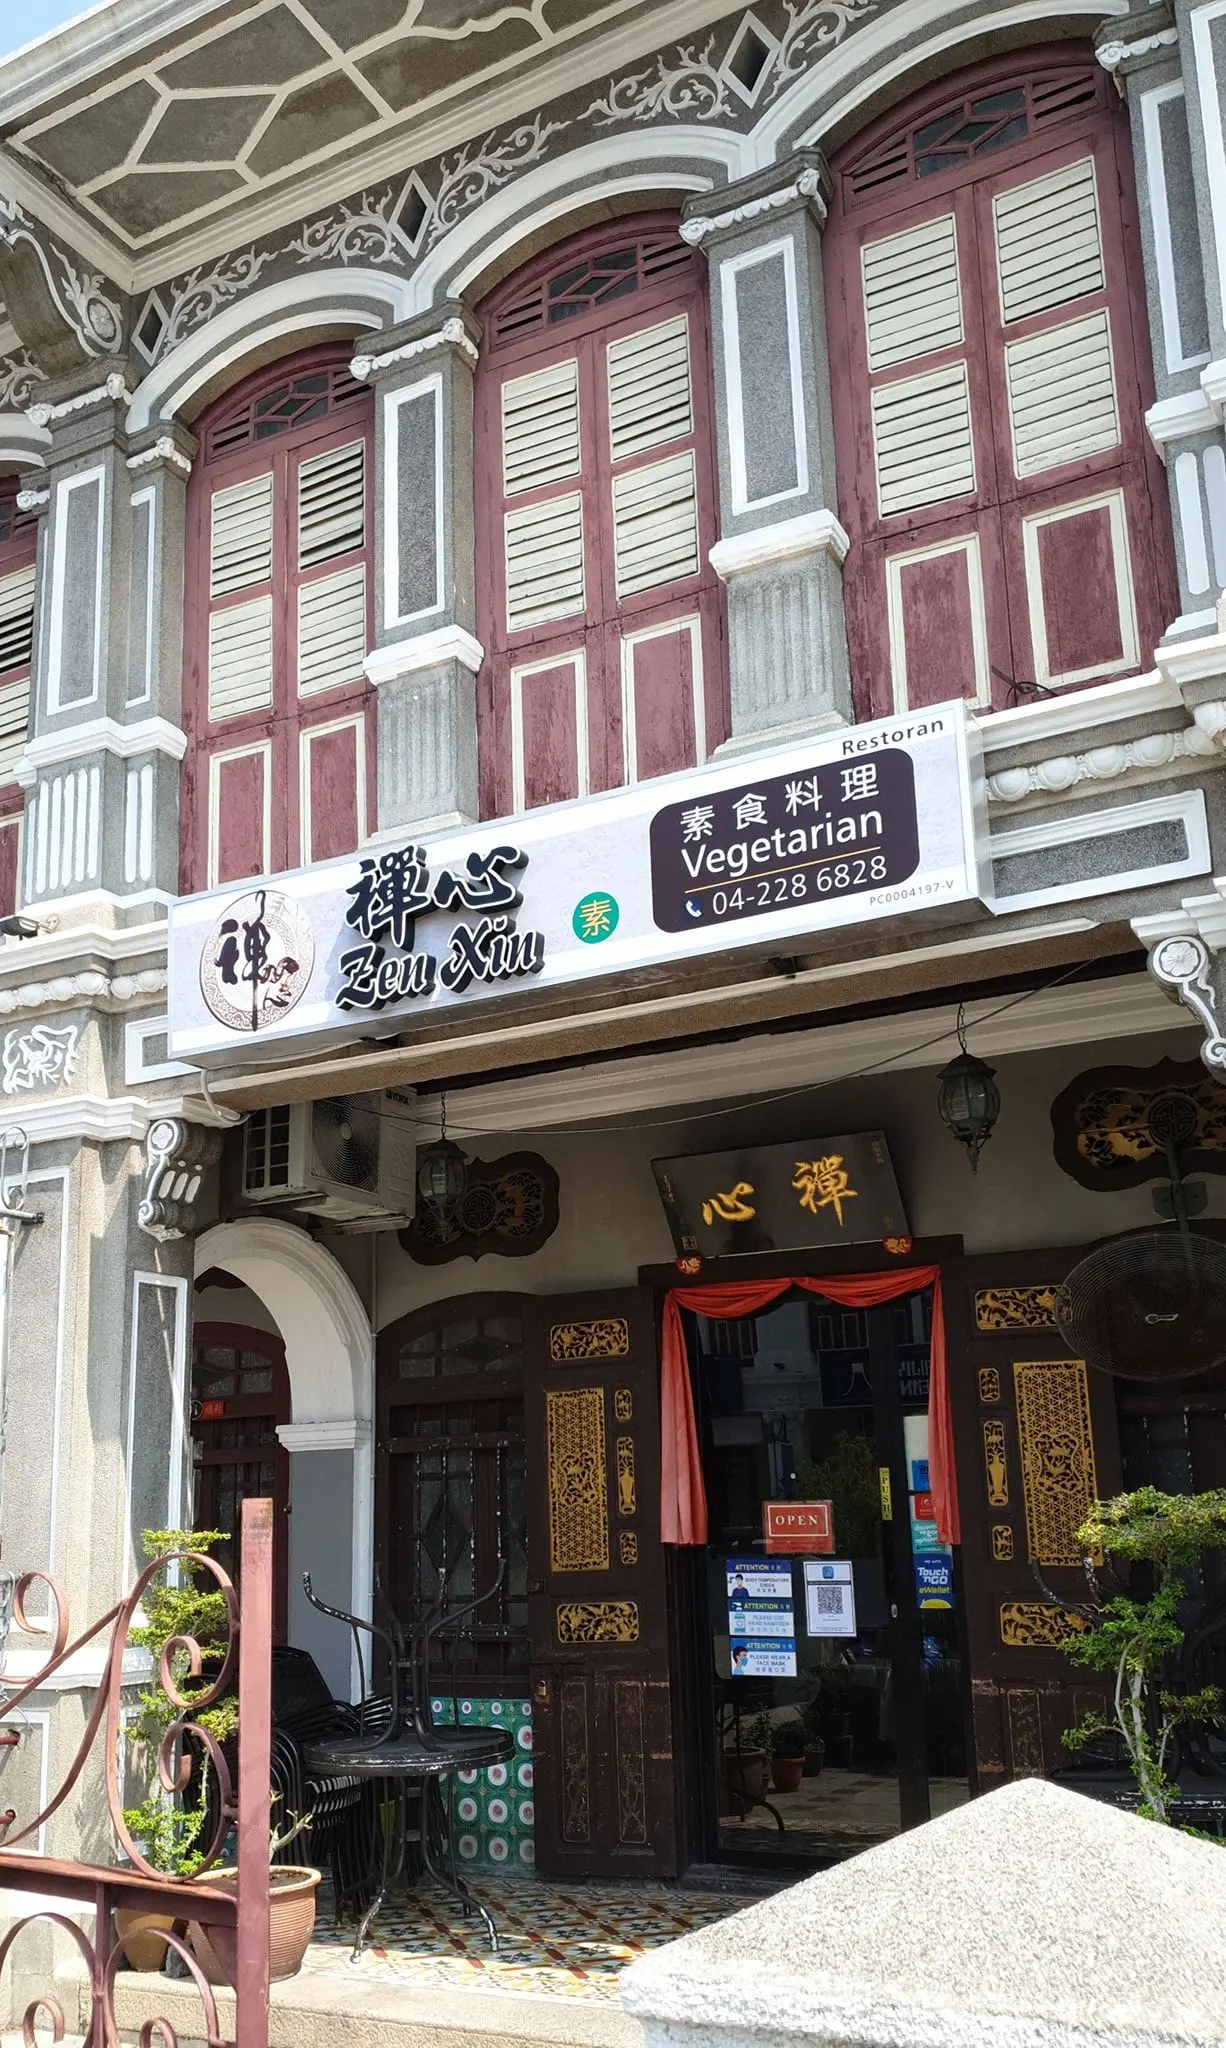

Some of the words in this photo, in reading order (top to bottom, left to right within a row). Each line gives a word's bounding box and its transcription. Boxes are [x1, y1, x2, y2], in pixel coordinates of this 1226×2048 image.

[841, 718, 945, 756] Restoran
[680, 763, 880, 843] 素食料理
[681, 808, 883, 878] Vegetarian
[712, 874, 807, 917] 04-228
[816, 855, 888, 893] 6828
[869, 879, 955, 906] PC0004197-V
[577, 899, 612, 938] 素
[335, 944, 435, 1011] Zen
[439, 914, 545, 994] Xin
[881, 1476, 890, 1512] PUSH
[775, 1514, 818, 1526] OPEN
[917, 1567, 949, 1576] Touch
